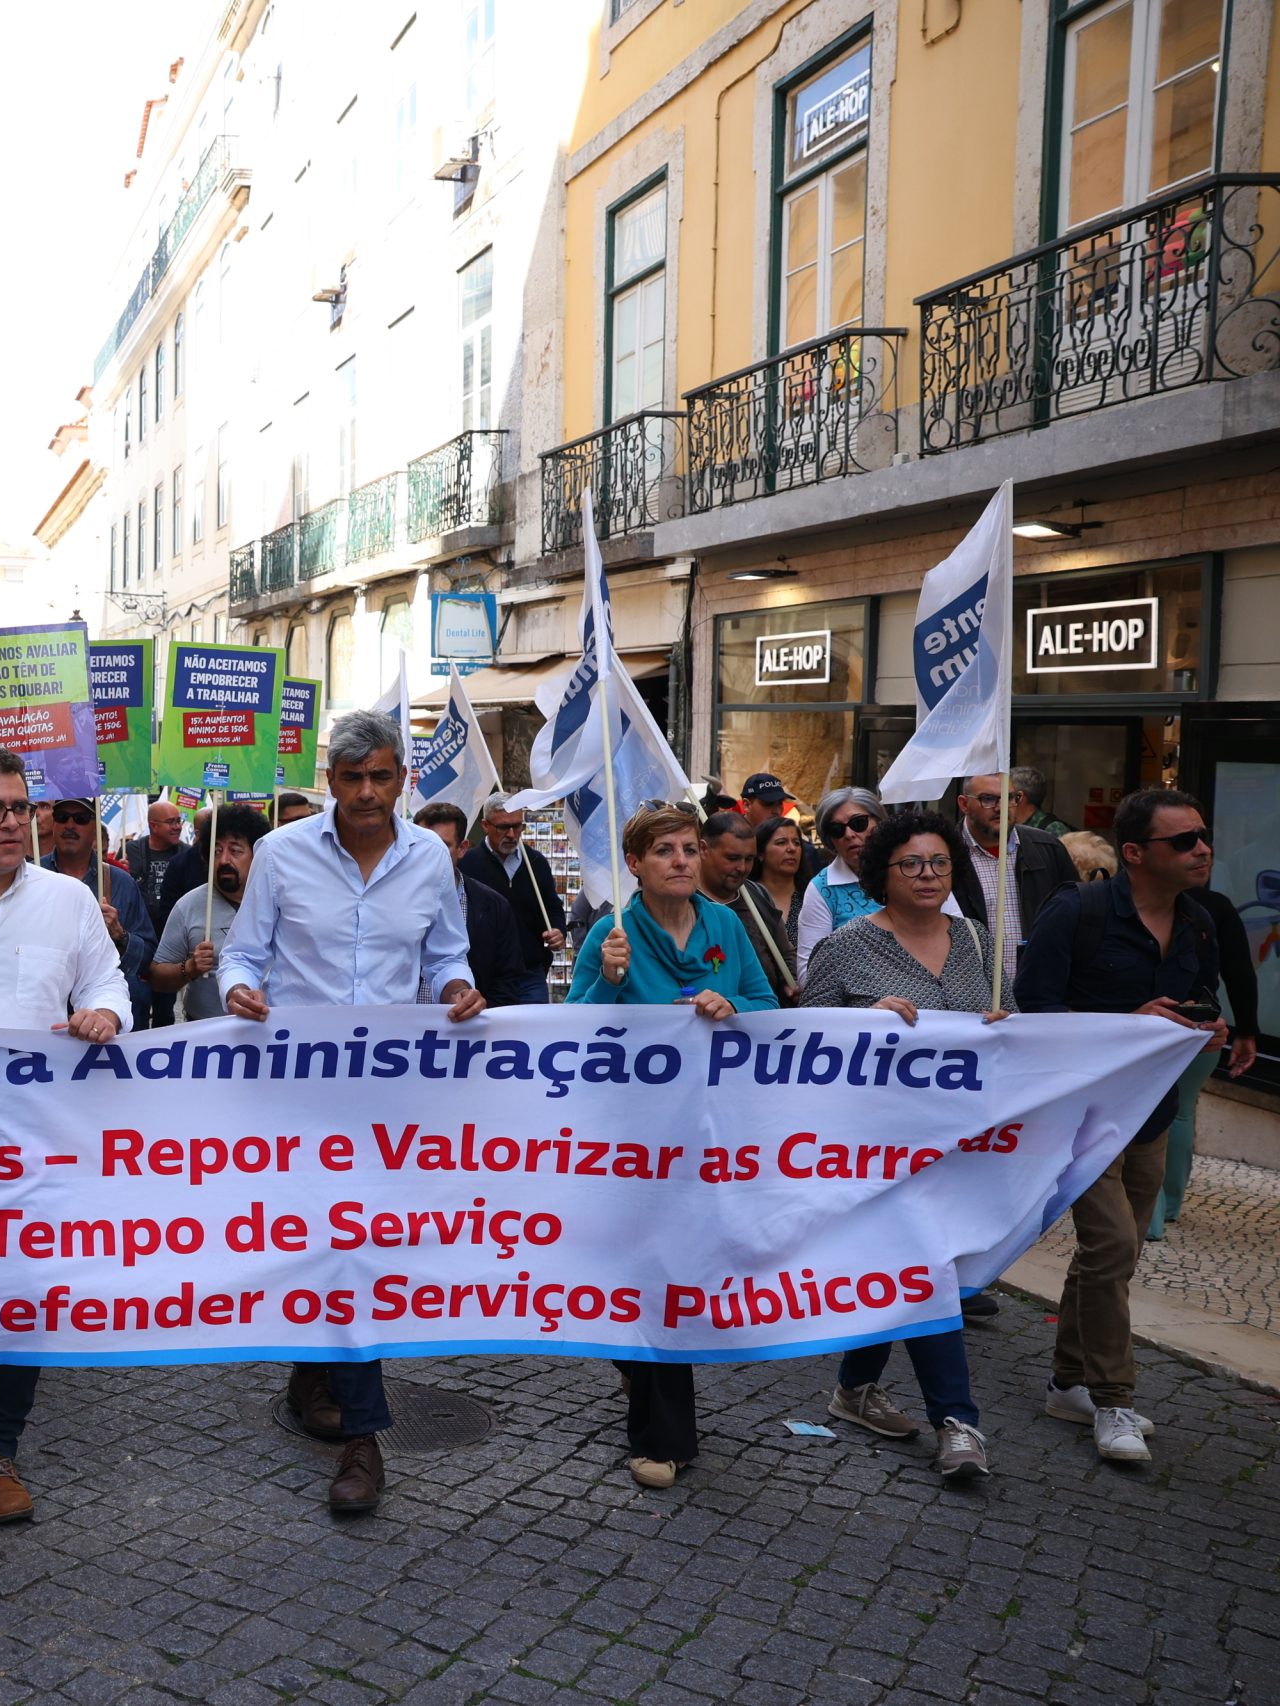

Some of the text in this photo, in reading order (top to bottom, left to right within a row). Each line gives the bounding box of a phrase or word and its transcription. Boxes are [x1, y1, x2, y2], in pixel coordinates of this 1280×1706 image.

[809, 83, 869, 142] ALE-HOP
[446, 628, 486, 638] Dental Life
[1038, 617, 1145, 656] ALE-HOP
[26, 642, 77, 658] AVALIAR
[90, 654, 135, 668] EITAMOS
[184, 654, 267, 673] NÃO ACEITAMOS
[762, 644, 823, 673] ALE-HOP
[12, 663, 38, 678] TÊM
[40, 663, 56, 676] DE
[91, 671, 127, 684] BRECER
[9, 681, 63, 697] ROUBAR!
[190, 673, 258, 689] EMPOBRECER
[186, 688, 260, 704] A TRABALHAR
[281, 700, 304, 710] RECER
[95, 711, 118, 722] ENTO!
[191, 715, 246, 725] 15% AUMENTO!
[281, 711, 305, 722] ALHAR
[17, 722, 54, 736] QUOTAS
[188, 725, 249, 735] MÍNIMO DE 150€
[71, 1026, 681, 1098] Administração
[707, 1028, 982, 1091] Pública
[101, 1128, 301, 1185] Repor
[319, 1134, 354, 1172] e
[371, 1123, 683, 1180] Valorizar
[699, 1144, 760, 1184] as
[224, 1201, 308, 1253] de
[328, 1197, 562, 1260] Serviço
[281, 1287, 355, 1326] os
[371, 1270, 641, 1333] Serviços
[663, 1265, 935, 1330] Públicos
